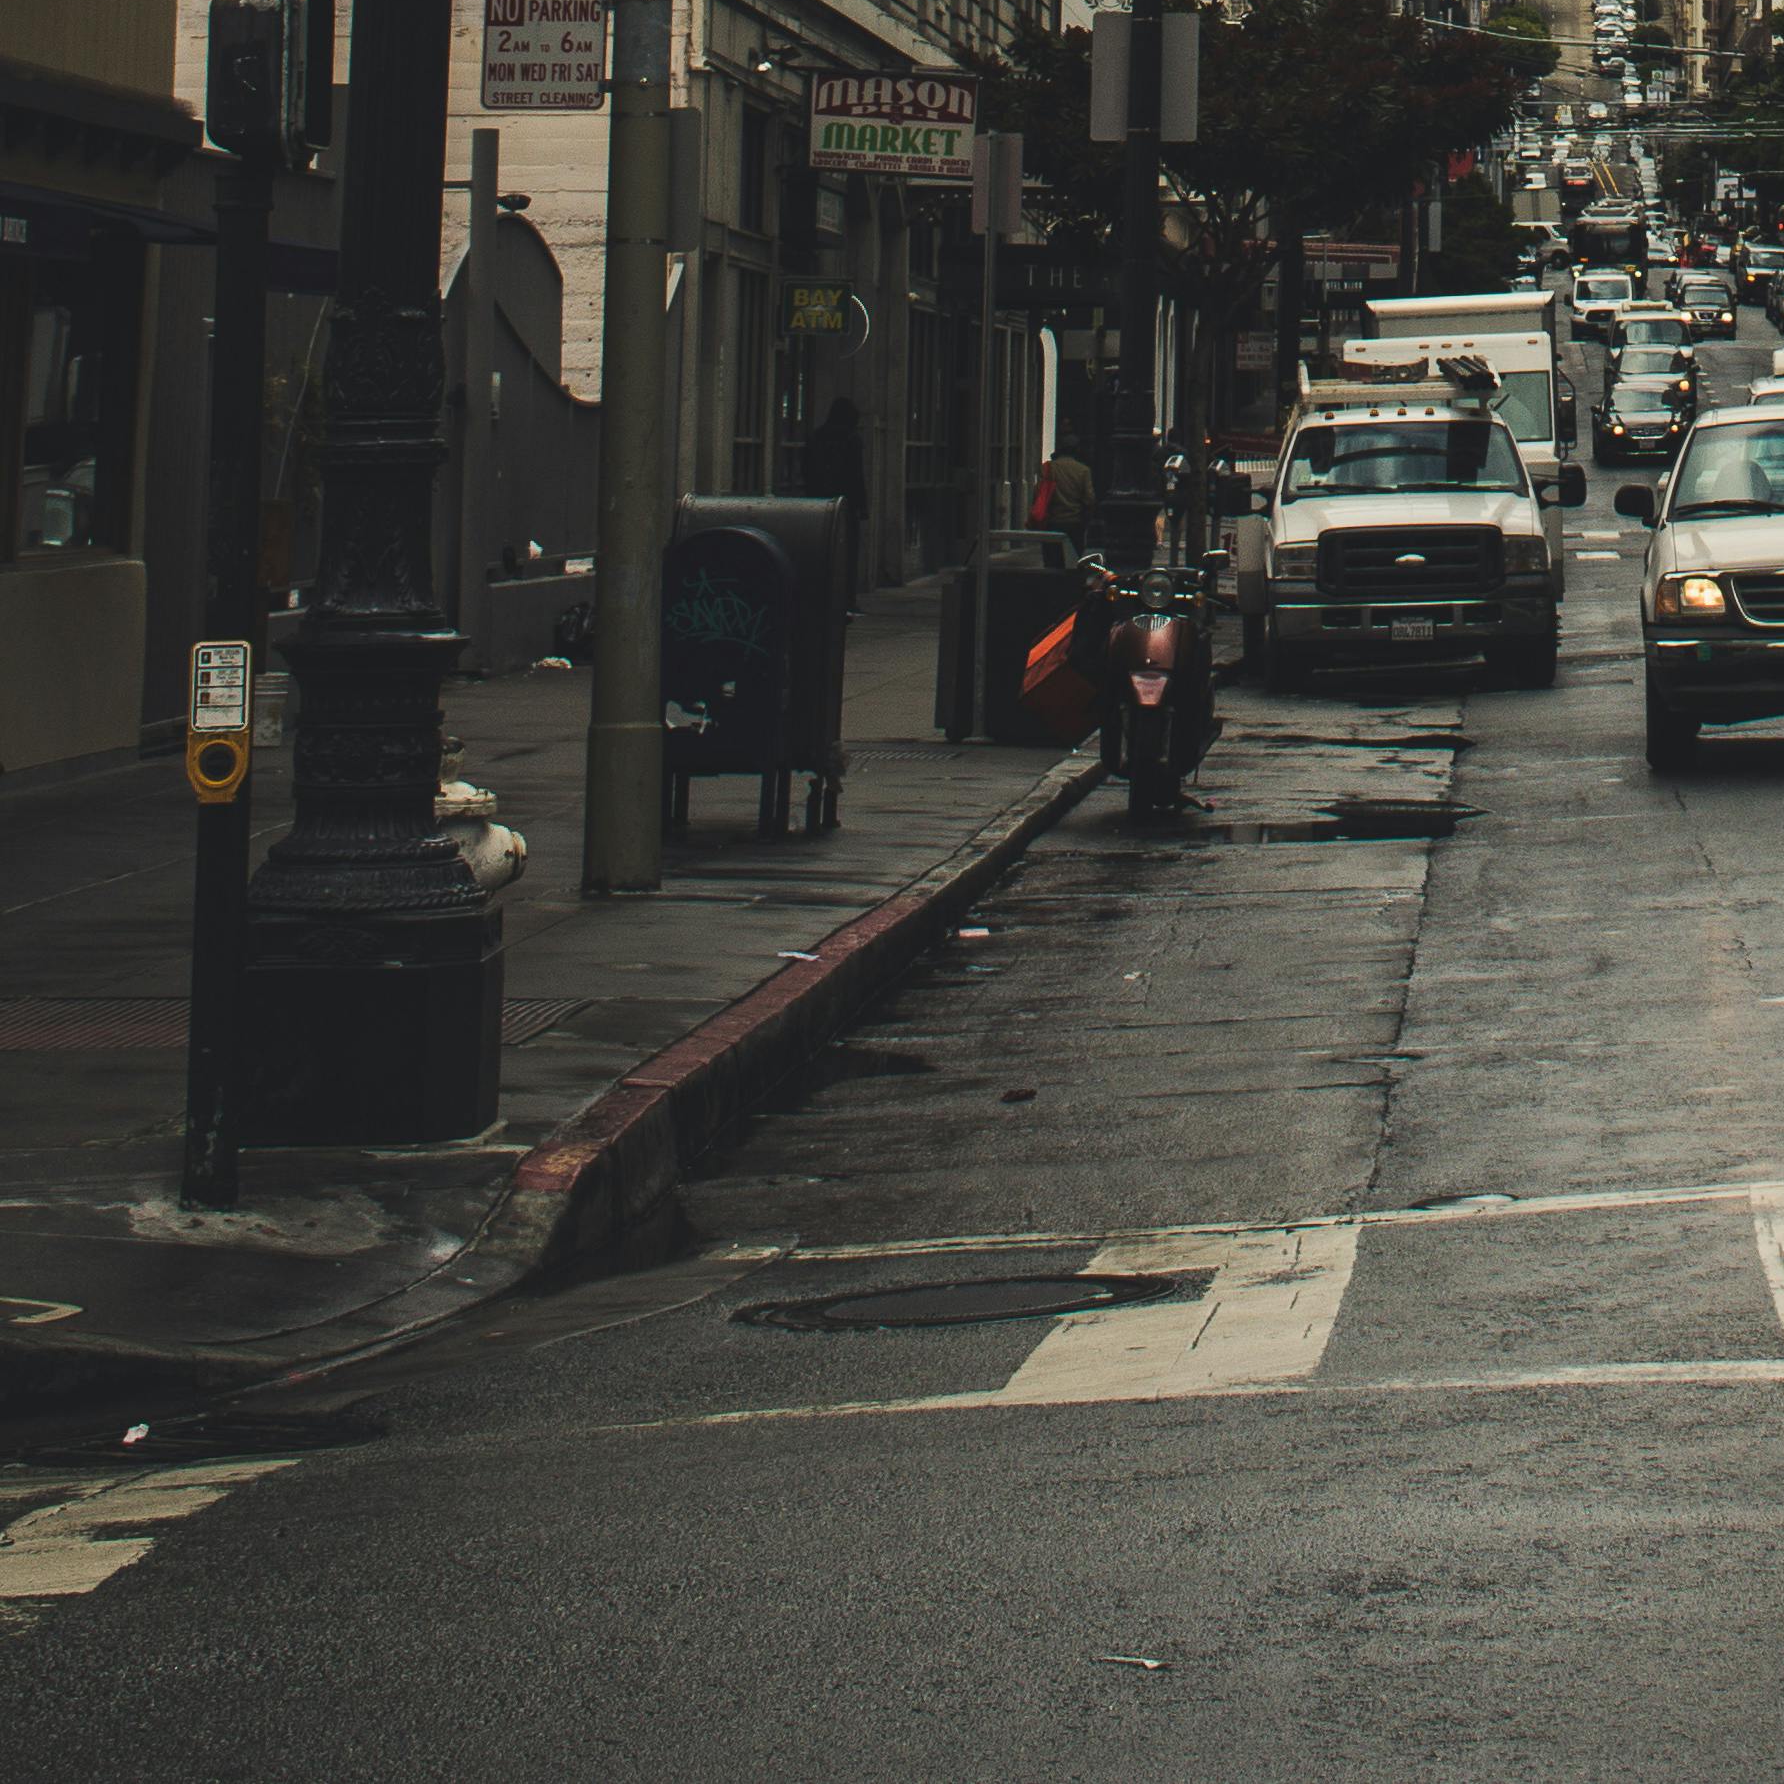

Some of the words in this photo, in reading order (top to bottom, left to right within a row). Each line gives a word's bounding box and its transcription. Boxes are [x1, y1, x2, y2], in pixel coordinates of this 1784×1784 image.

[528, 0, 601, 22] PARKING
[488, 63, 515, 81] MON
[520, 63, 547, 81] WED
[551, 63, 571, 81] FRI
[576, 63, 600, 81] SAT
[492, 92, 533, 104] STREET
[540, 92, 594, 104] CLEANING
[817, 76, 973, 120] MASON
[822, 122, 961, 156] MARKET
[793, 288, 843, 306] BAY
[789, 310, 843, 329] ATM
